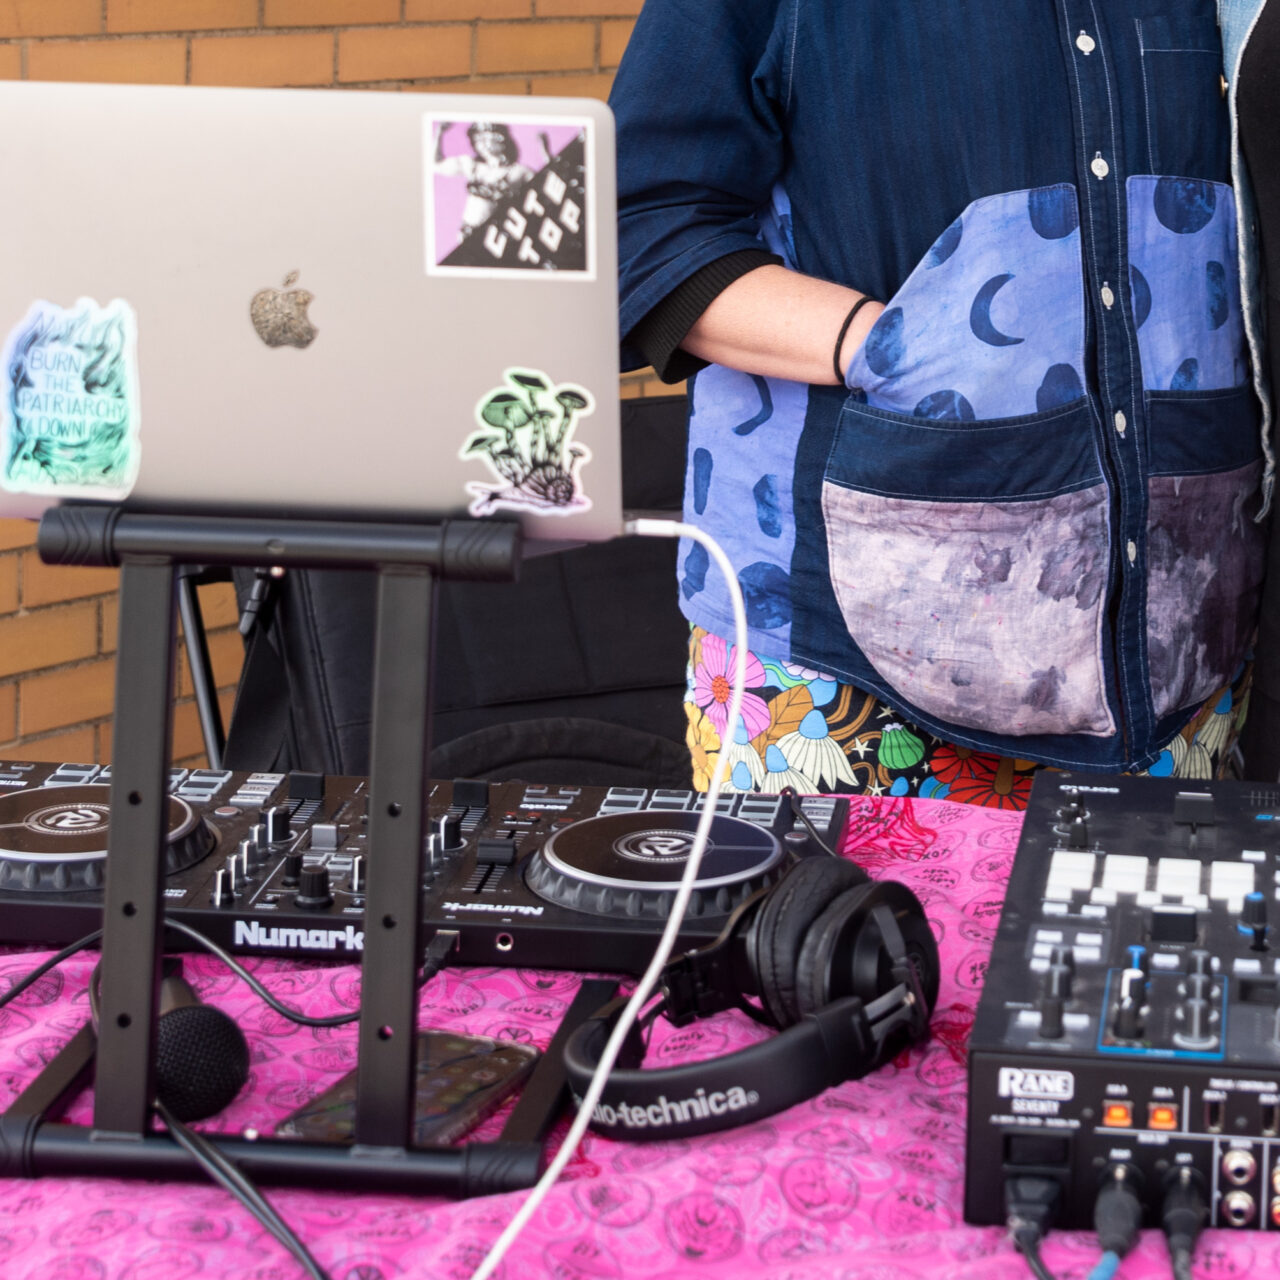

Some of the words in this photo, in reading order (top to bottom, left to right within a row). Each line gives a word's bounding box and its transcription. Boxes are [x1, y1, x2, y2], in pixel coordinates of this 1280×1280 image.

[483, 170, 567, 259] CUTE
[518, 198, 581, 264] TOP
[30, 349, 81, 374] BURN
[44, 374, 75, 394] THE
[21, 393, 126, 419] PATRIARCHY
[441, 901, 544, 916] Numark
[234, 920, 365, 951] Numark
[999, 1067, 1073, 1100] RANE
[1012, 1098, 1060, 1116] SEVENTY
